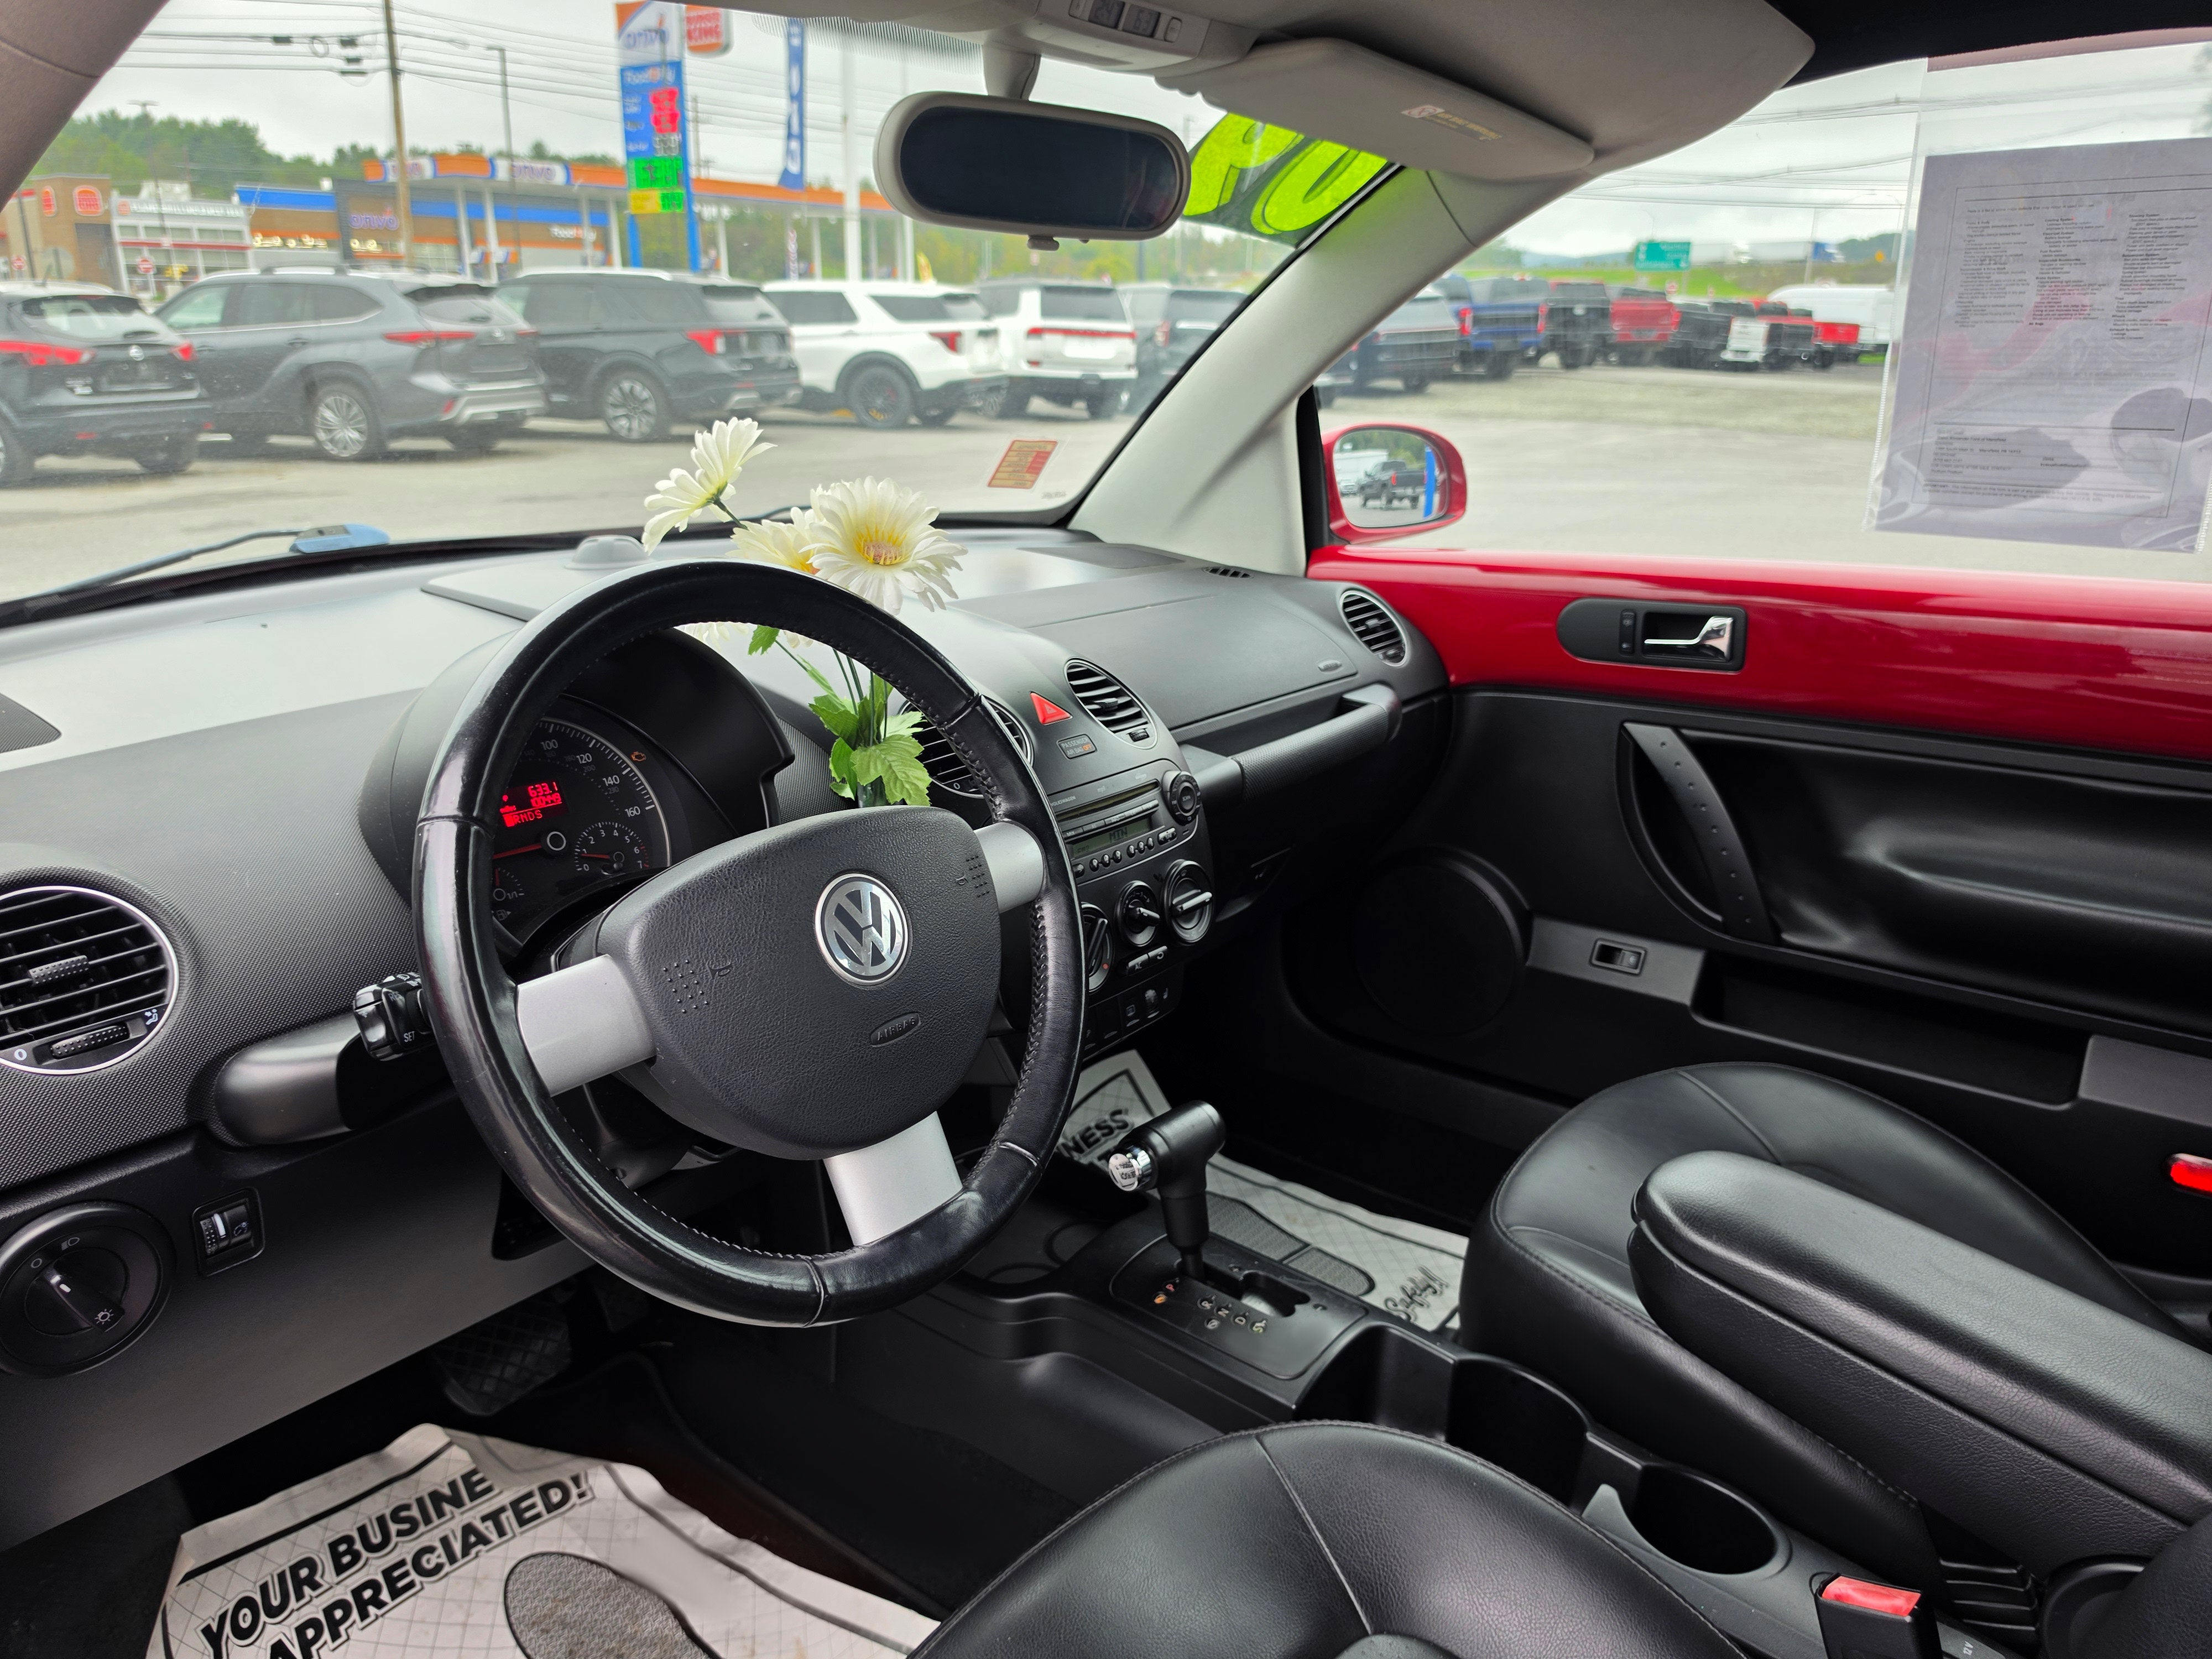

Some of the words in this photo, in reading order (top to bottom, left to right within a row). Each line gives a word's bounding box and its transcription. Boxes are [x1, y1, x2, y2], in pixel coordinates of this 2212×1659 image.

[540, 739, 559, 750] 100
[576, 753, 592, 764] 120
[602, 775, 620, 786] 140
[528, 781, 558, 797] 633.1
[624, 806, 641, 817] 160
[637, 860, 643, 869] 7
[877, 1016, 916, 1041] AIRBAG
[403, 1031, 415, 1042] SET
[1059, 1109, 1129, 1157] NESS
[1234, 1316, 1246, 1326] D
[200, 1555, 325, 1659] YOUR
[326, 1467, 495, 1578] BUSINE
